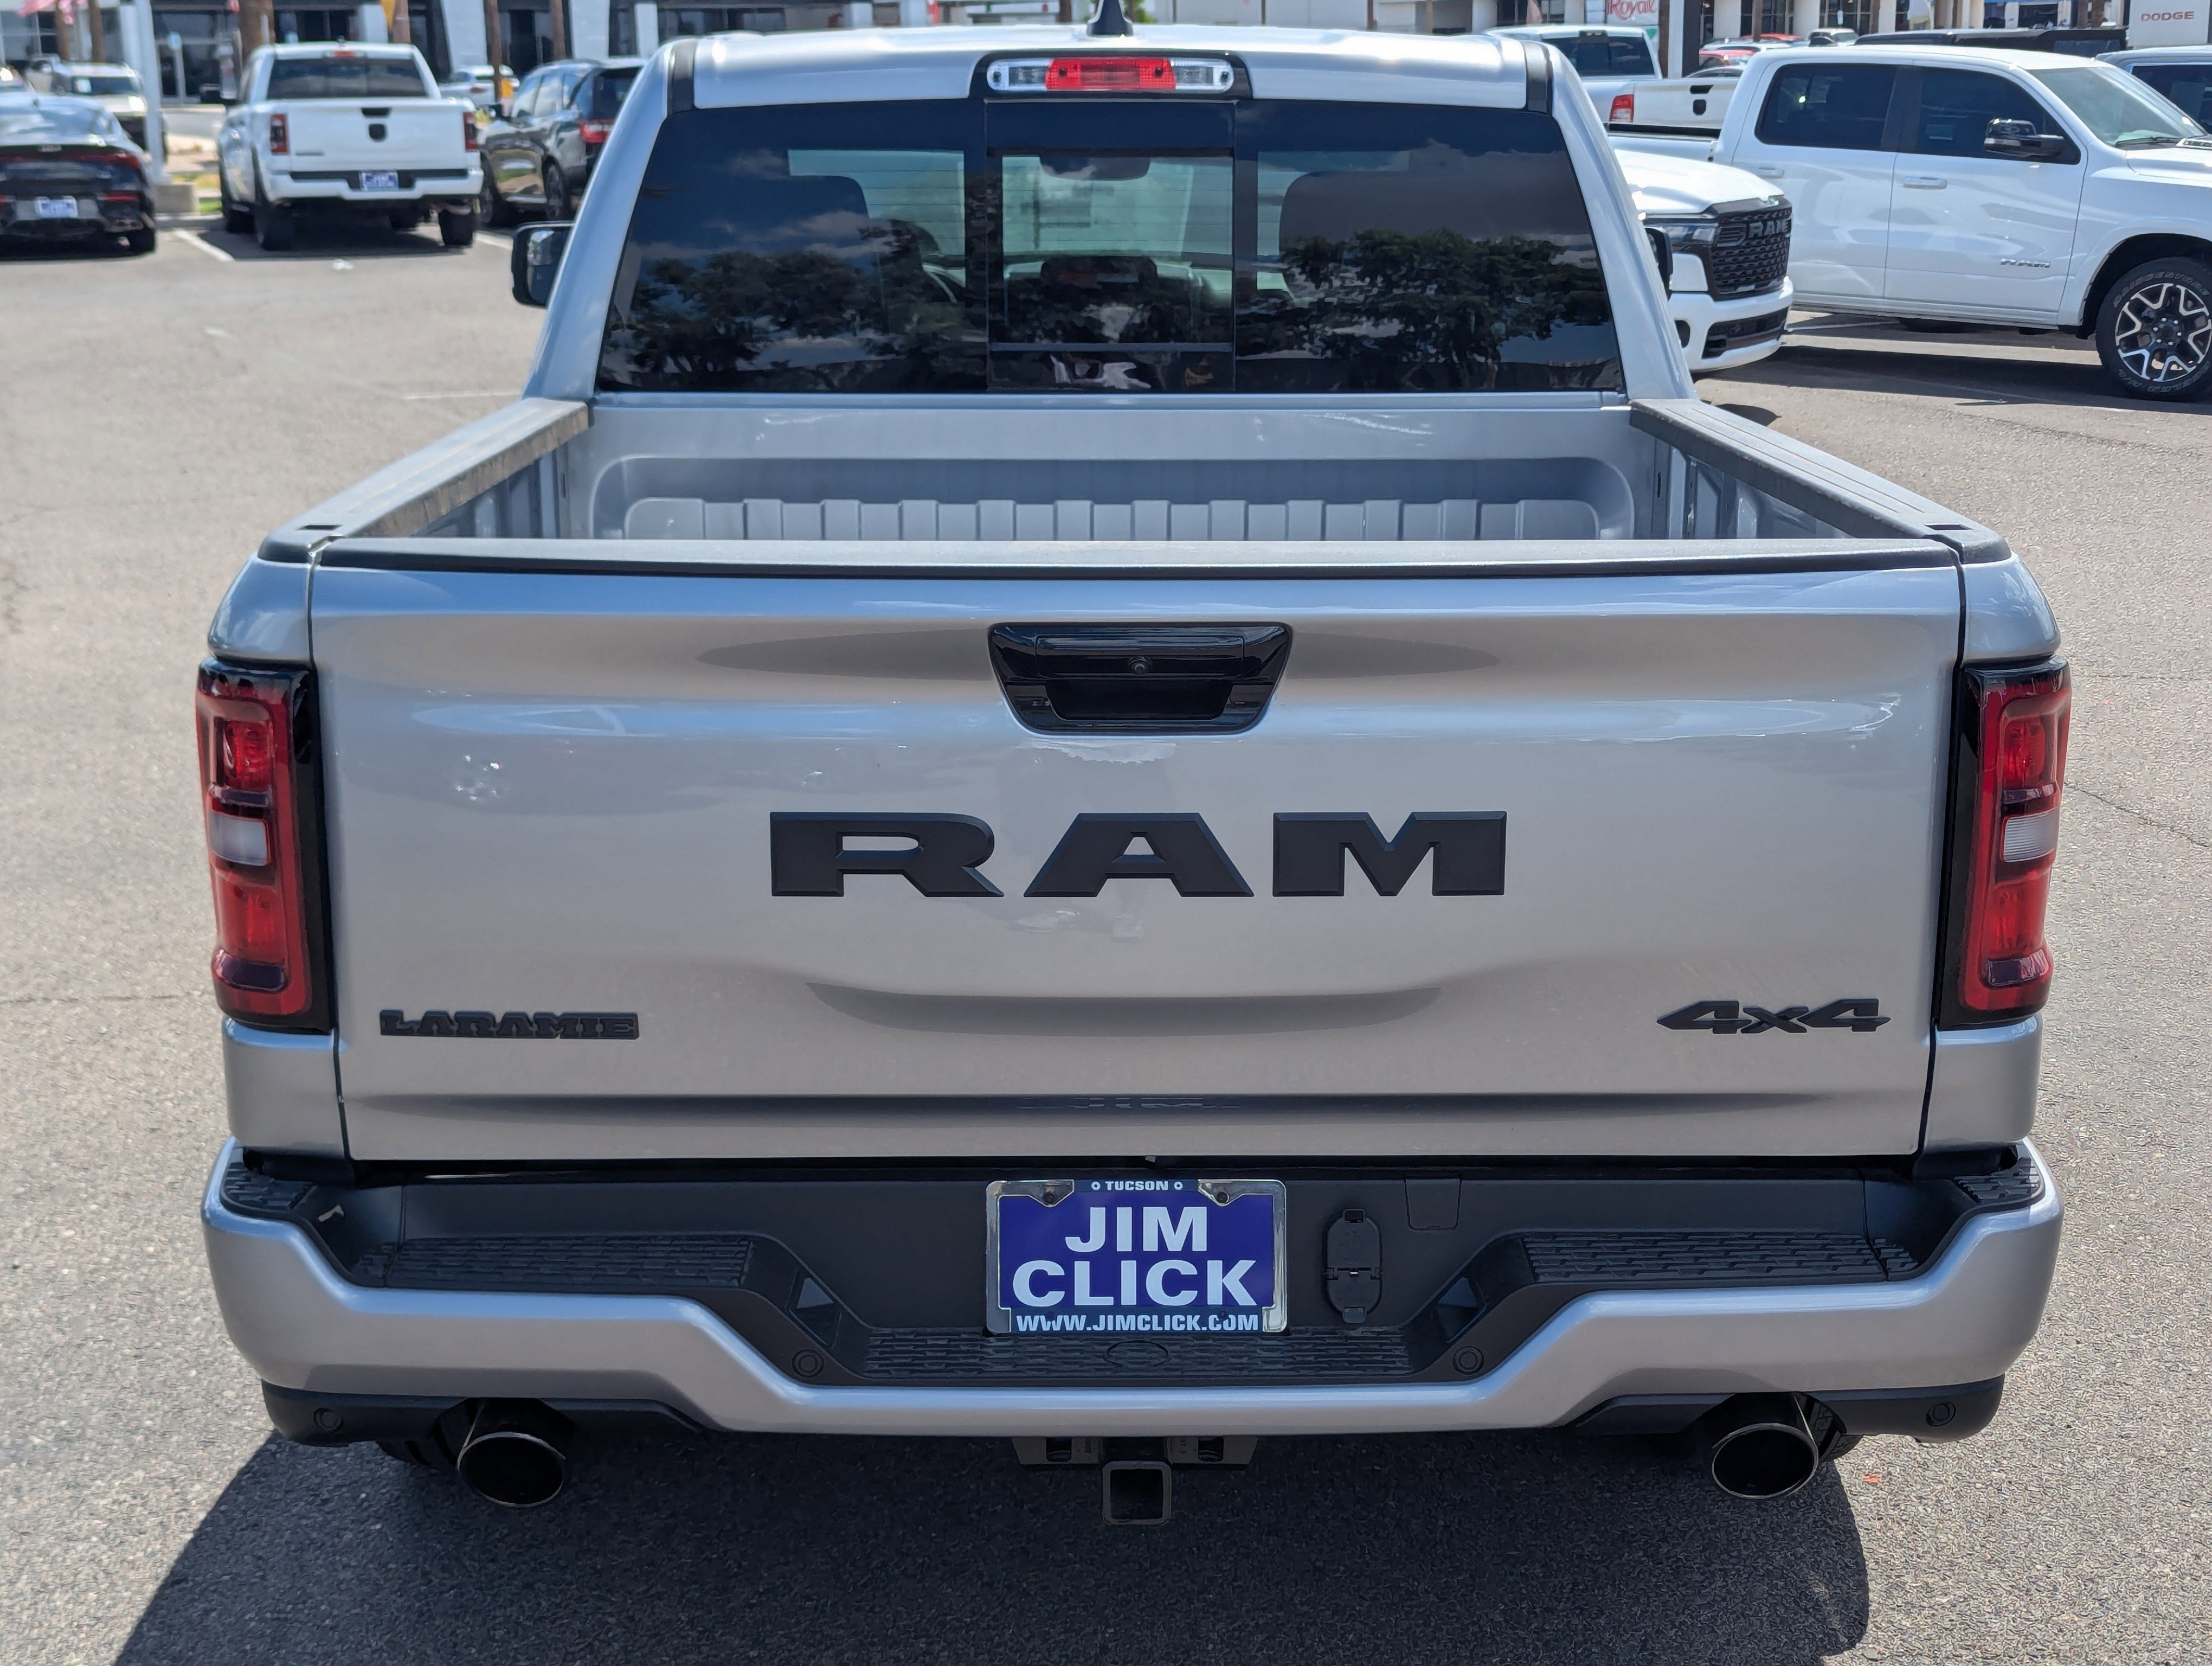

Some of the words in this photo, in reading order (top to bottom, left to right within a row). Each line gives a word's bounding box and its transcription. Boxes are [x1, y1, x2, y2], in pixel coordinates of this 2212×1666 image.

[2140, 11, 2194, 21] DODGE
[1748, 219, 1789, 238] RAM
[770, 811, 1507, 897] RAM
[380, 1009, 639, 1039] LARAMIE
[1656, 998, 1891, 1034] 4x4
[1105, 1181, 1168, 1191] TUCSON
[1065, 1207, 1207, 1252] JIM
[1012, 1260, 1257, 1307] CLICK
[1017, 1314, 1258, 1332] WWW.JIMCLICK.COM
